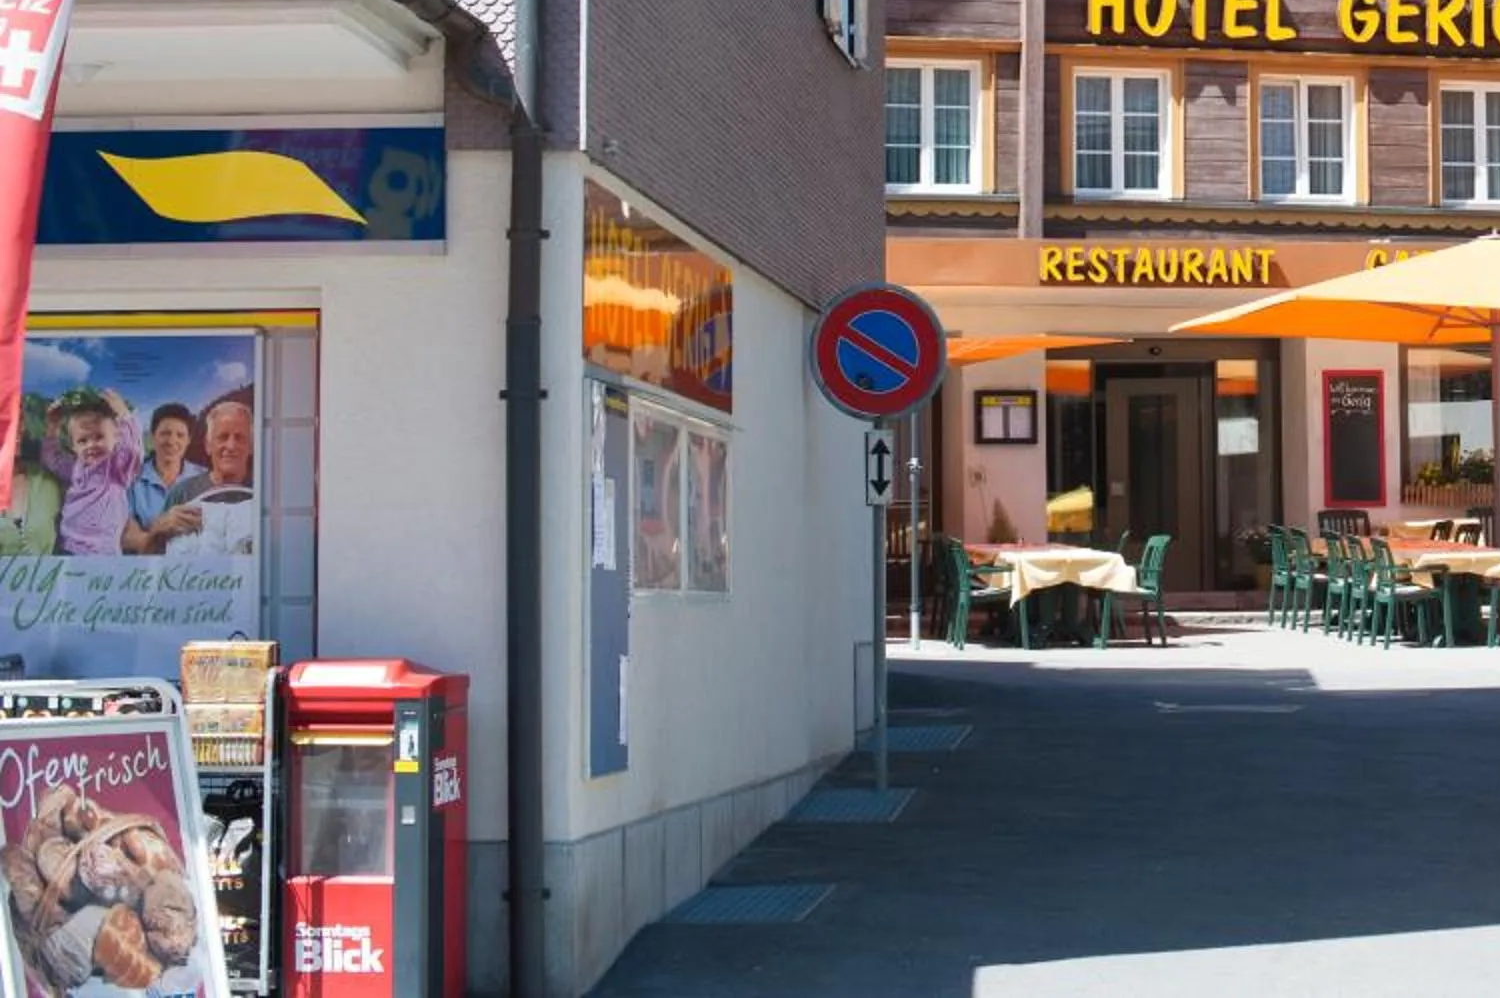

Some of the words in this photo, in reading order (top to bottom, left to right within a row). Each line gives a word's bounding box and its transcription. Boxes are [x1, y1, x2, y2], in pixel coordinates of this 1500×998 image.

[1038, 245, 1277, 286] RESTAURANT
[119, 565, 149, 592] die
[157, 562, 243, 592] Kleinen
[43, 598, 77, 624] die
[296, 922, 371, 941] Sonntags
[294, 936, 385, 973] Blick
